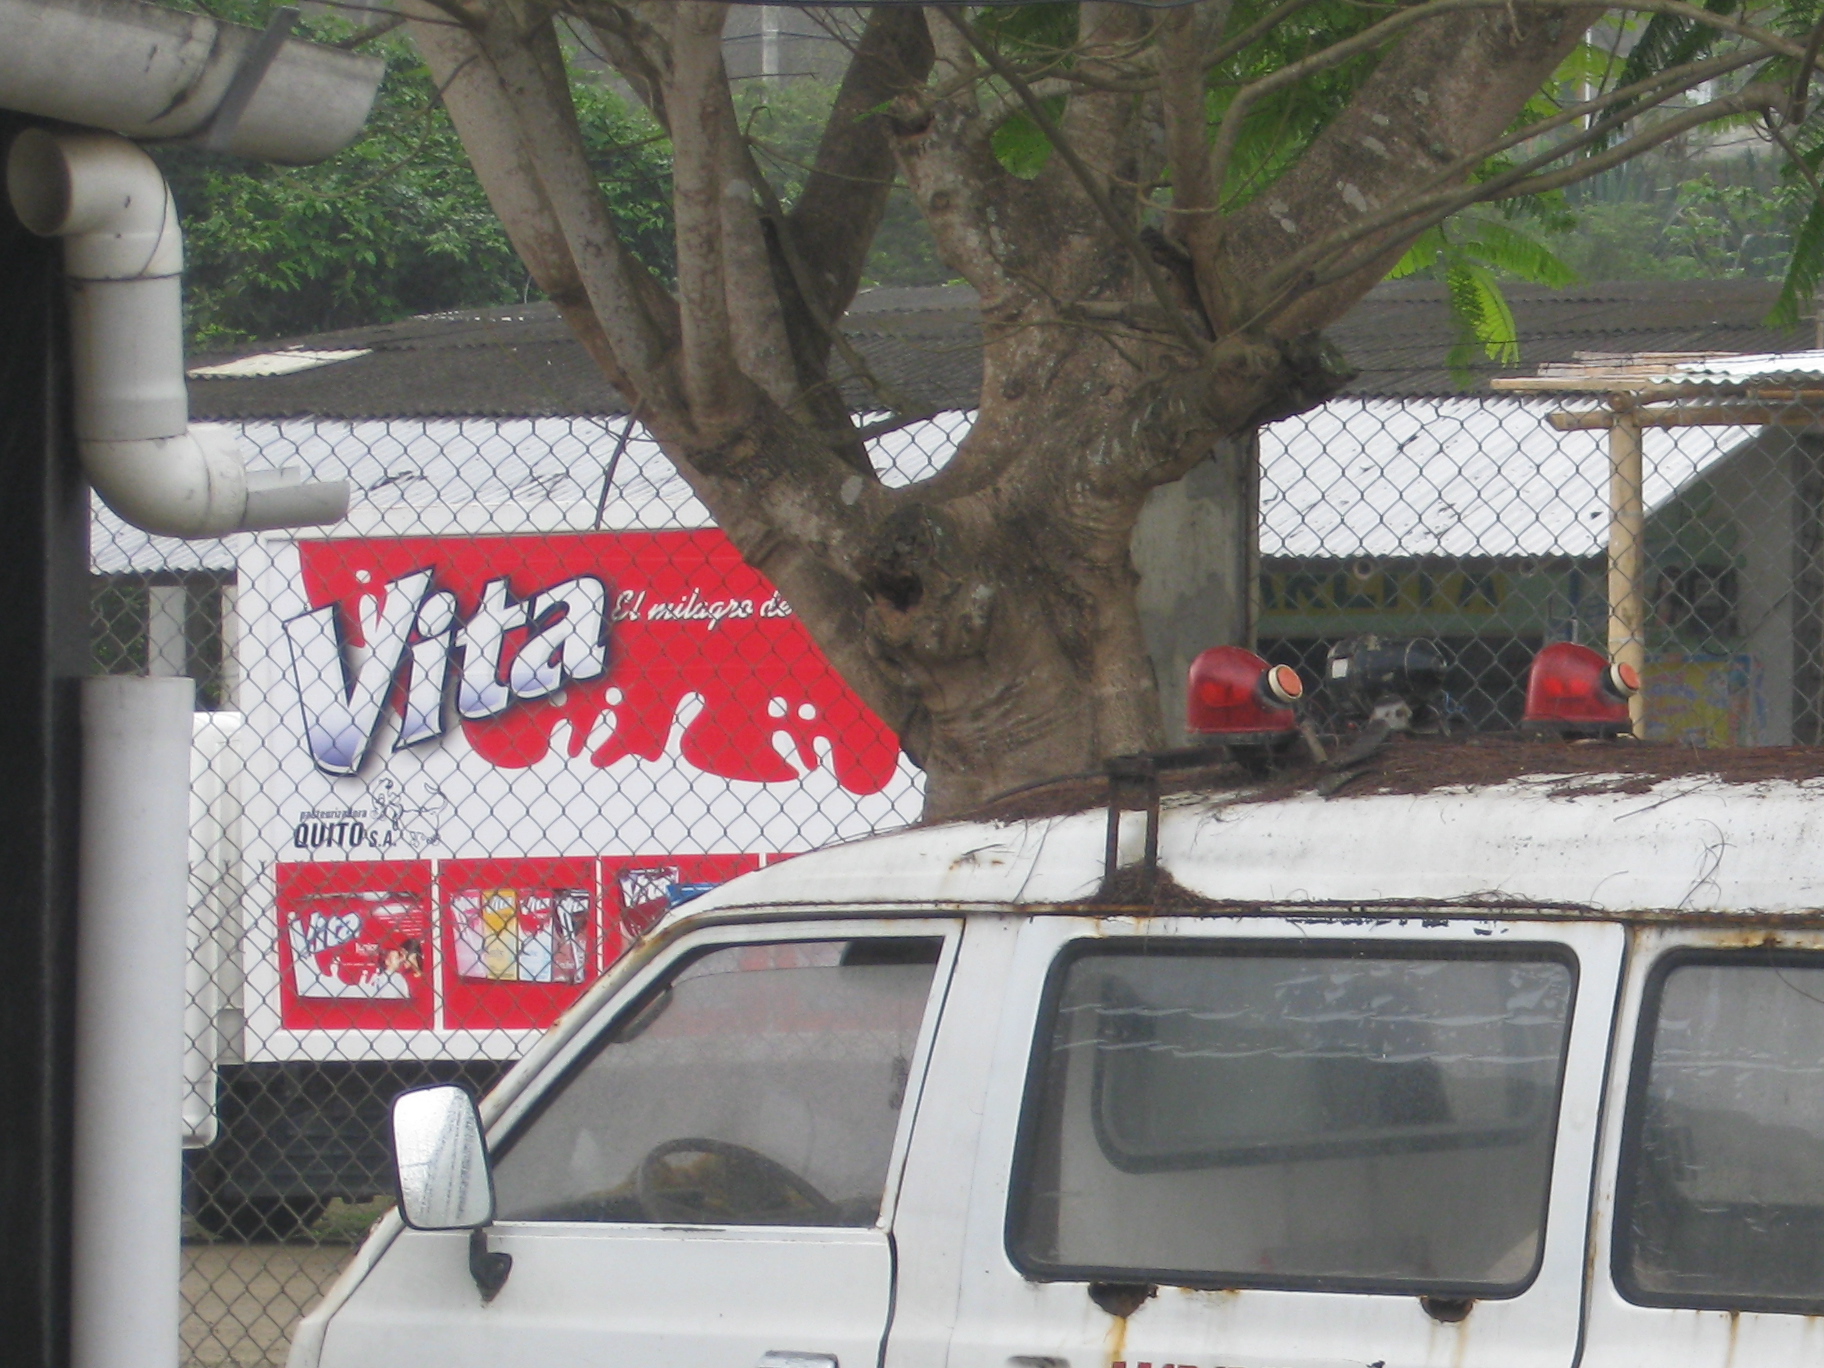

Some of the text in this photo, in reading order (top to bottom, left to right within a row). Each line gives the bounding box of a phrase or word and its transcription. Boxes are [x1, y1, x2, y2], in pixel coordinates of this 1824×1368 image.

[611, 587, 793, 631] El milagro de
[282, 564, 607, 777] Vita
[294, 821, 397, 849] QUITO S.A.
[299, 808, 368, 820] pasteurizadora
[287, 910, 362, 956] Vita
